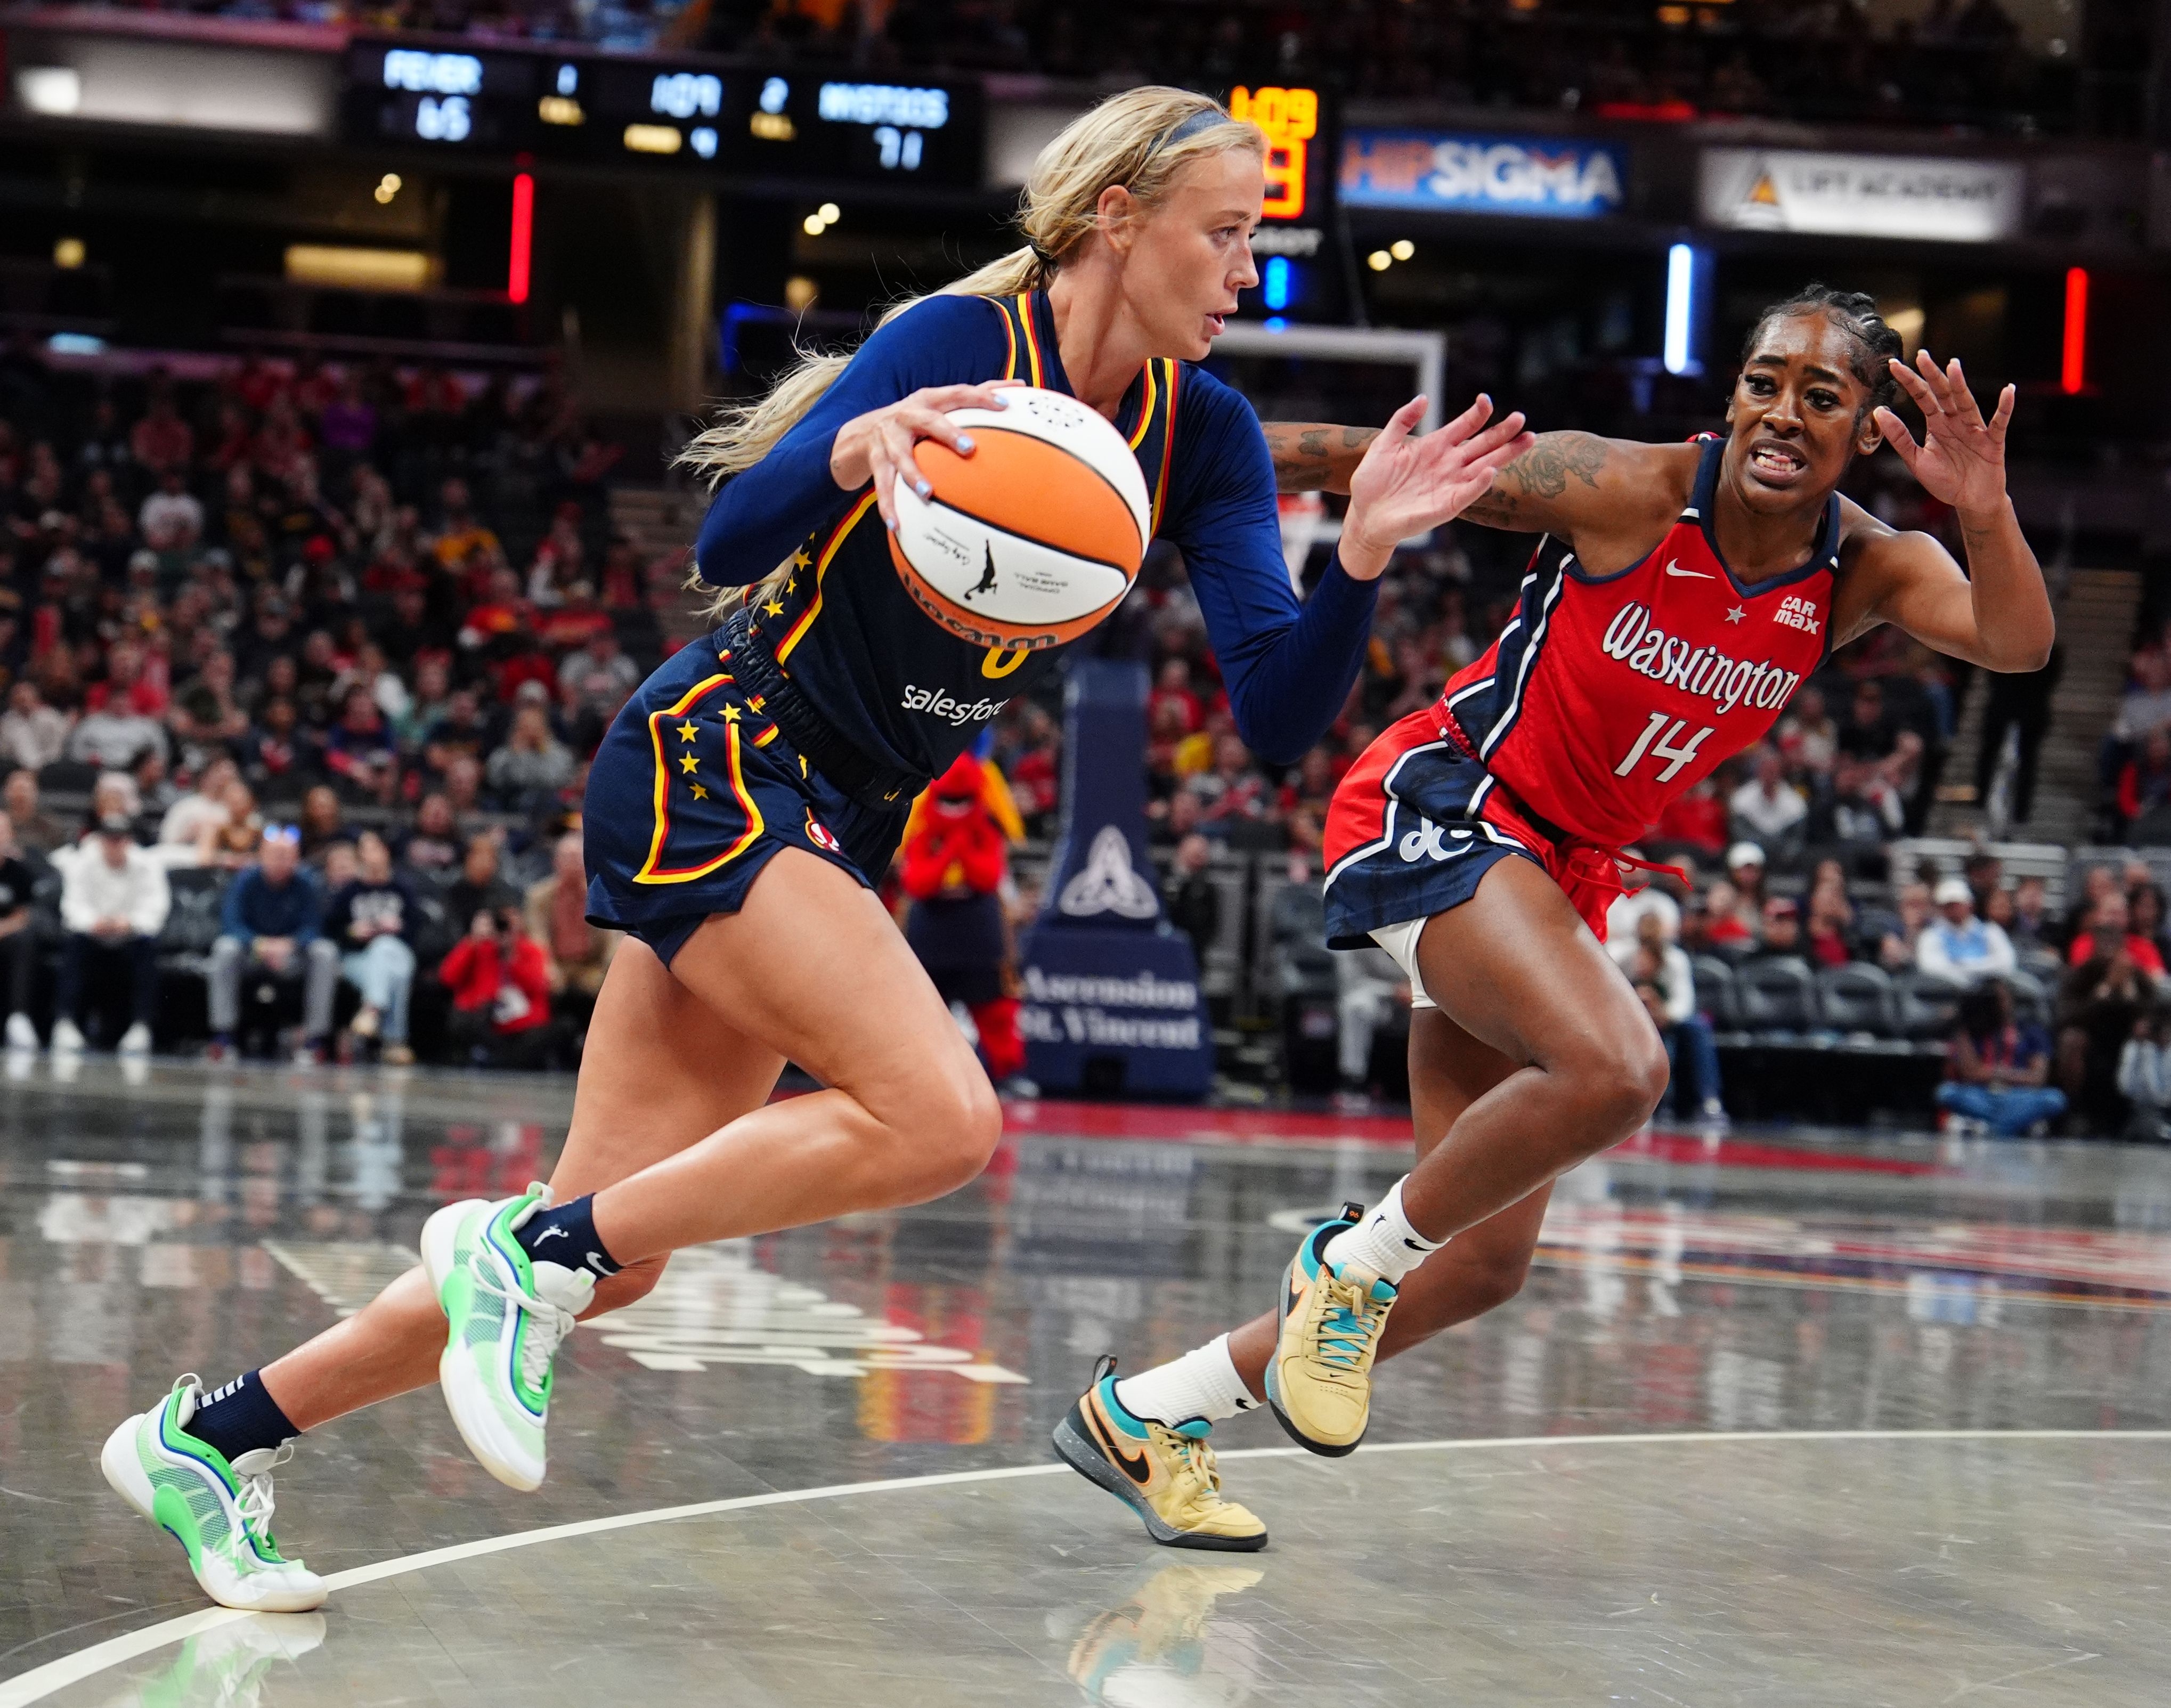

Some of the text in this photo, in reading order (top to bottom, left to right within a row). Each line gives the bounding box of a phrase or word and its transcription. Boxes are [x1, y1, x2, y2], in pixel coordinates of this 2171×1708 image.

[1780, 596, 1817, 617] CAR
[1601, 599, 1800, 715] Washington
[1613, 711, 1717, 783] 14
